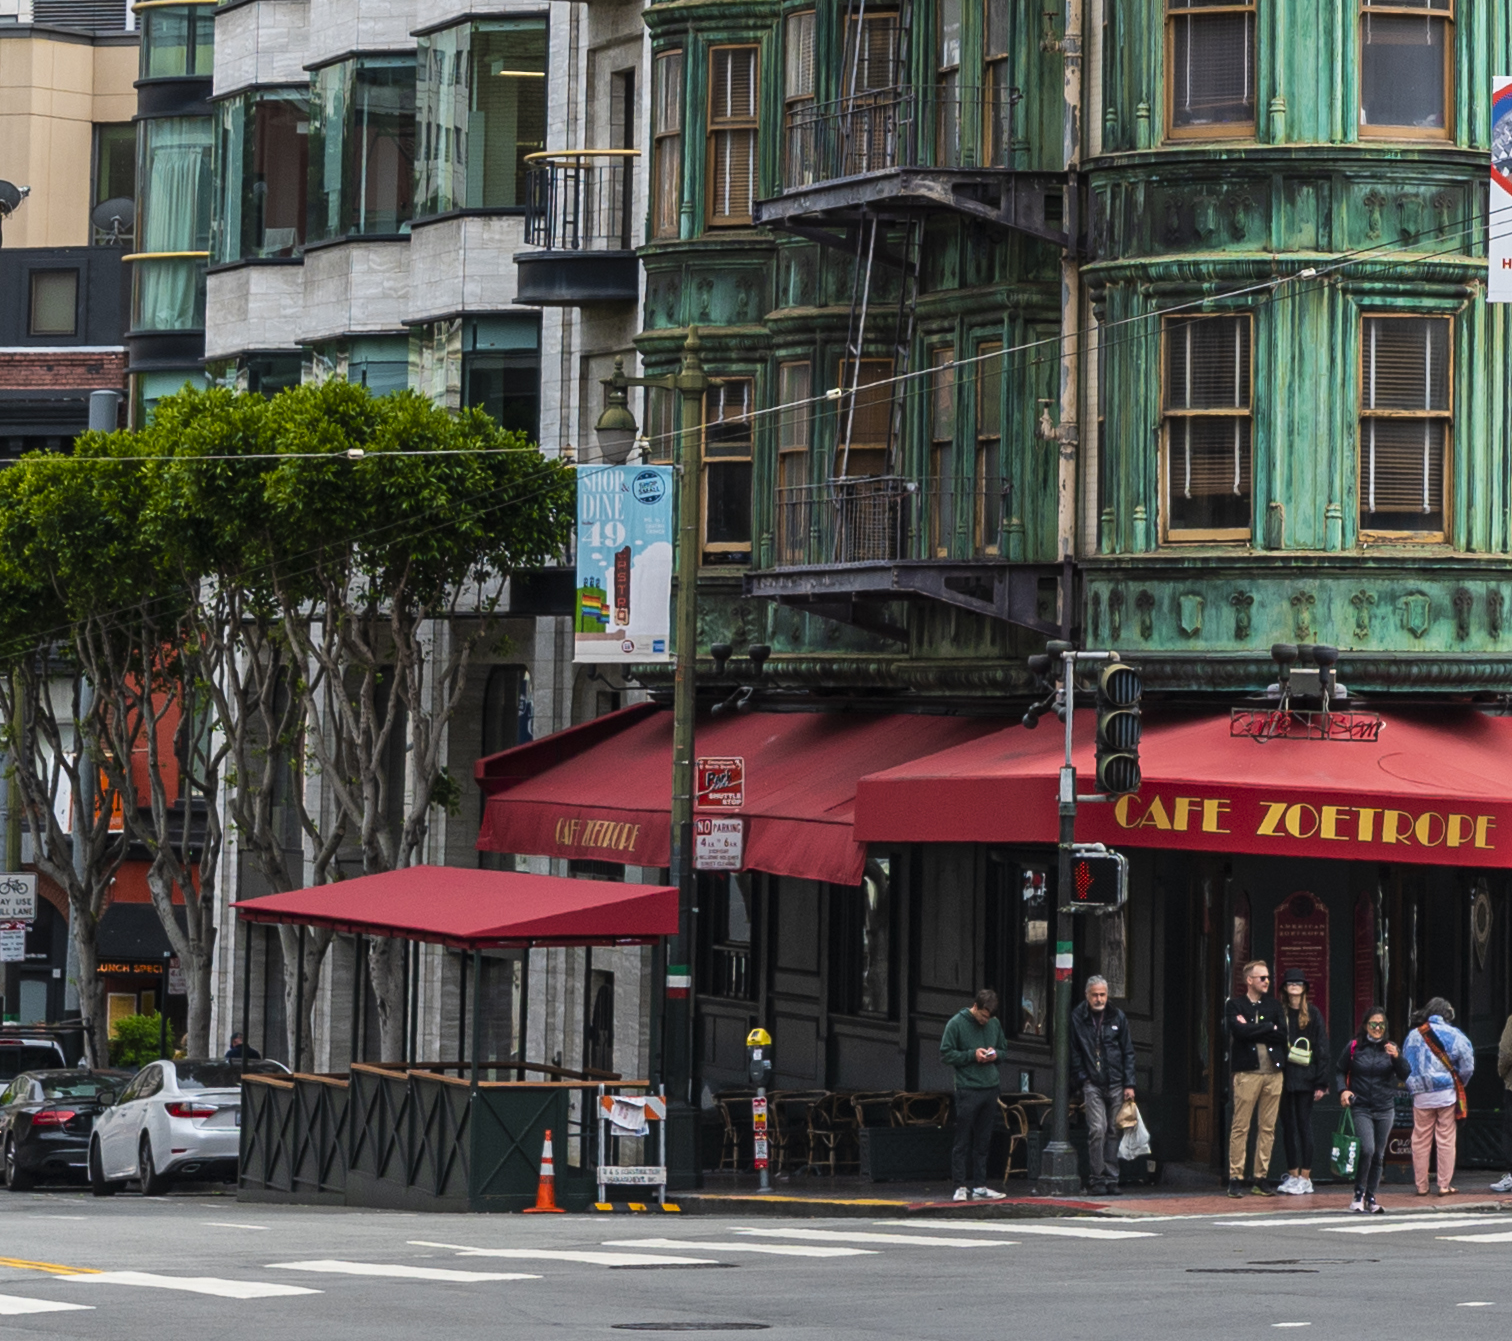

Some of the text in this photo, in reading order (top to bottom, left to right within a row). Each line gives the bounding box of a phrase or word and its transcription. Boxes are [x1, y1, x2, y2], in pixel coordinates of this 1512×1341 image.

[581, 470, 625, 492] SHOP
[581, 493, 625, 520] DINE
[581, 521, 626, 548] 49
[697, 820, 741, 833] NO PARKING
[1115, 794, 1497, 850] CAFE ZOETROPE
[700, 837, 707, 848] 4
[15, 897, 32, 905] USE
[12, 907, 34, 916] LANE
[133, 964, 163, 973] SPECI
